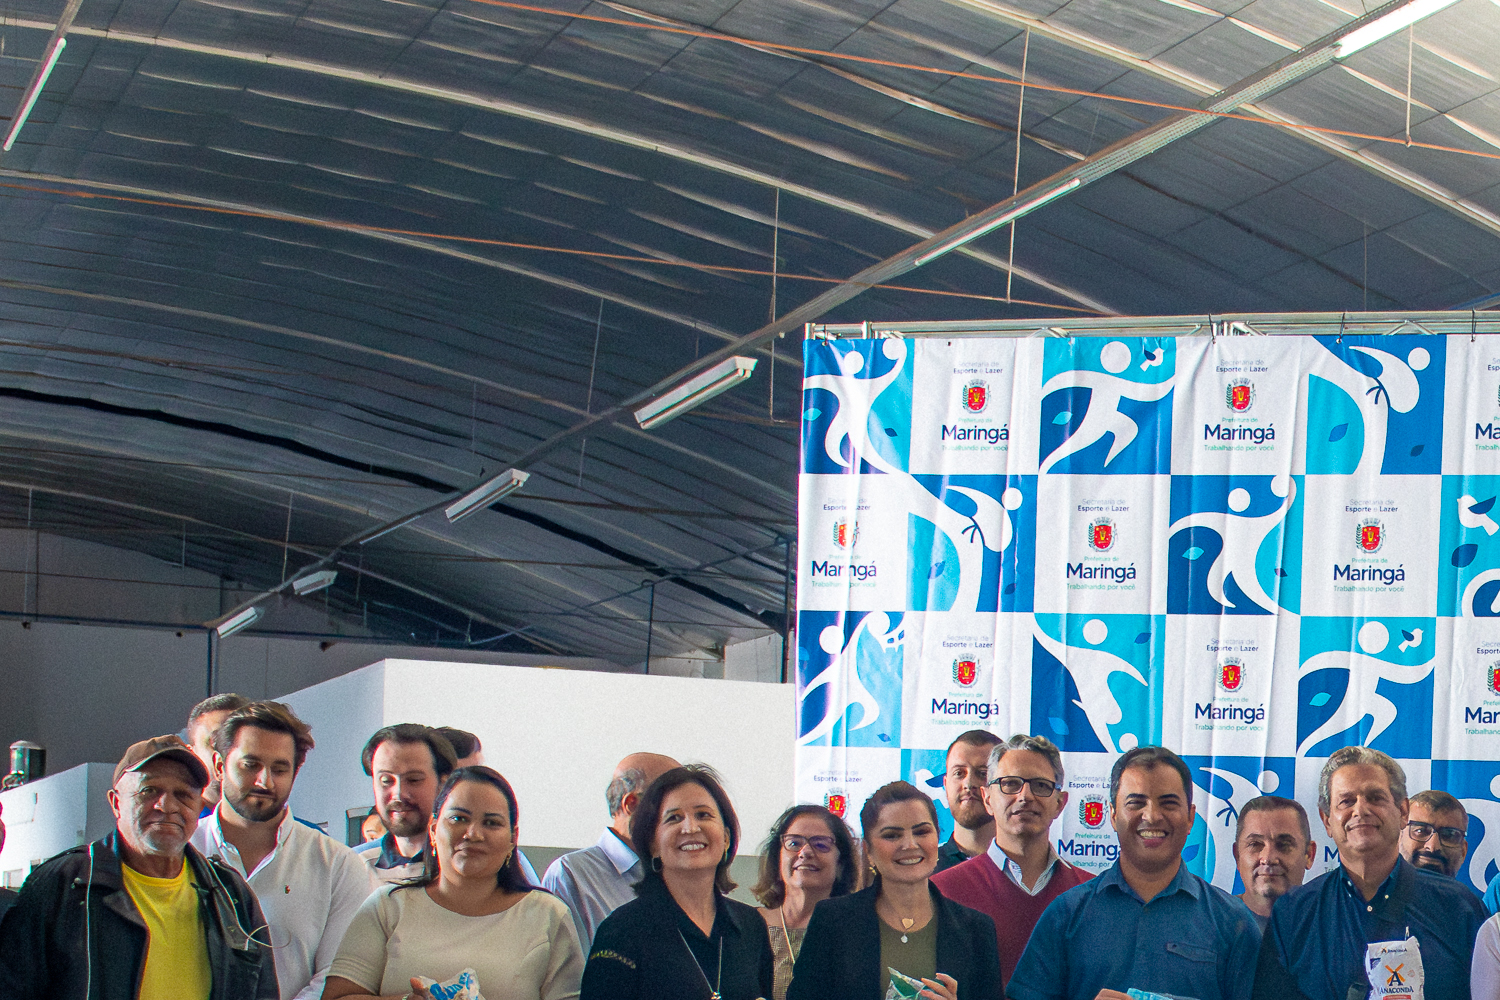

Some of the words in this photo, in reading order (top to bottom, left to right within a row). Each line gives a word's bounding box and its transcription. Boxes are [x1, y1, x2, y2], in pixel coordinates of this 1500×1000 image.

[942, 422, 1009, 441] Maringá
[1204, 423, 1275, 443] Maringá
[1066, 561, 1136, 581] Maringá
[1334, 563, 1405, 583] Maringá
[931, 698, 999, 717] Maringá
[1195, 703, 1264, 723] Maringá
[1058, 839, 1121, 861] Maring
[1379, 985, 1414, 995] ANACONDA
